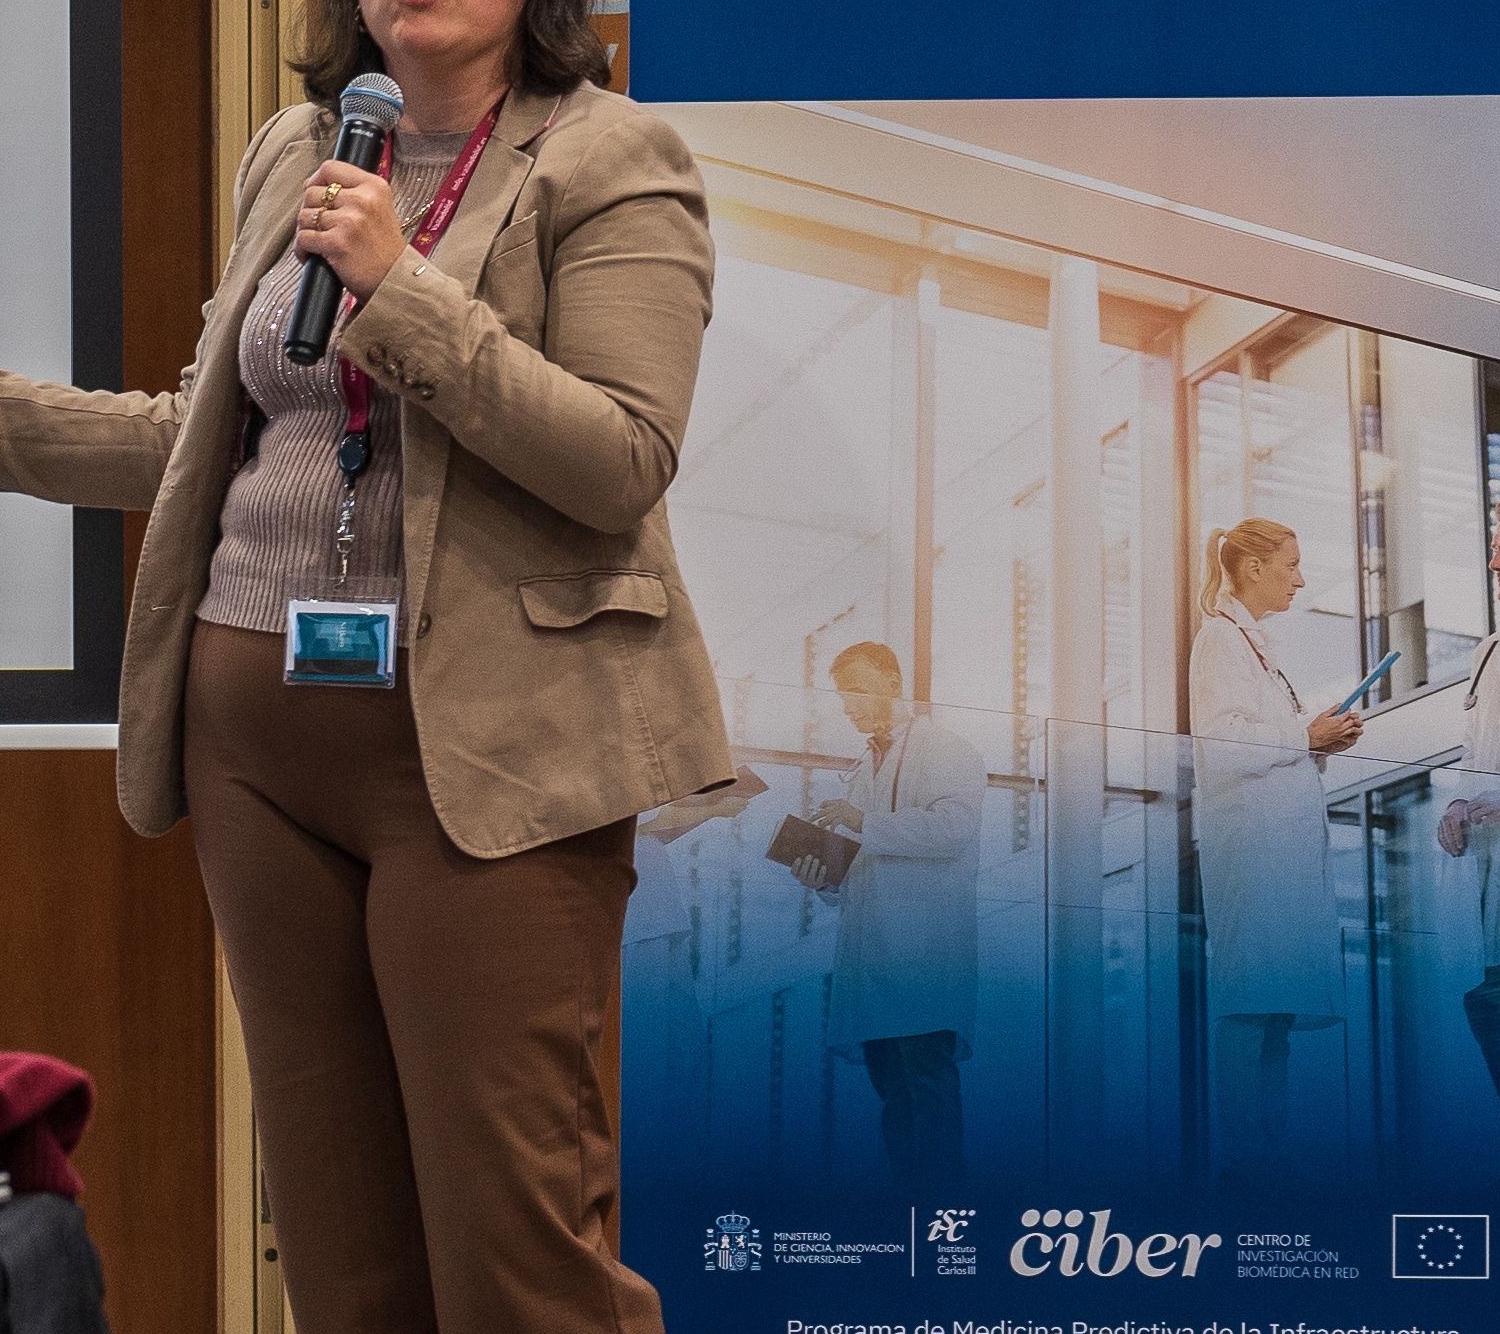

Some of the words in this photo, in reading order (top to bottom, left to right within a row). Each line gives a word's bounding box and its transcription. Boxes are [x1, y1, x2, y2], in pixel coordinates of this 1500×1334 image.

[774, 1232, 831, 1242] MINISTERIO
[1237, 1235, 1291, 1247] CENTRO
[1294, 1235, 1311, 1247] DE
[1010, 1209, 1222, 1277] ciber
[774, 1244, 787, 1253] DE
[836, 1243, 905, 1254] INNOVACIÓN
[938, 1245, 976, 1254] Instituto
[774, 1255, 780, 1264] Y
[783, 1255, 862, 1265] UNIVERSIDADES
[938, 1255, 948, 1265] de
[951, 1255, 976, 1265] Salud
[1237, 1249, 1339, 1263] INVESTIGACIÓN
[938, 1266, 967, 1275] Carlos
[1237, 1264, 1311, 1278] BIOMÉDICA
[1314, 1267, 1332, 1279] EN
[1335, 1267, 1360, 1279] RED
